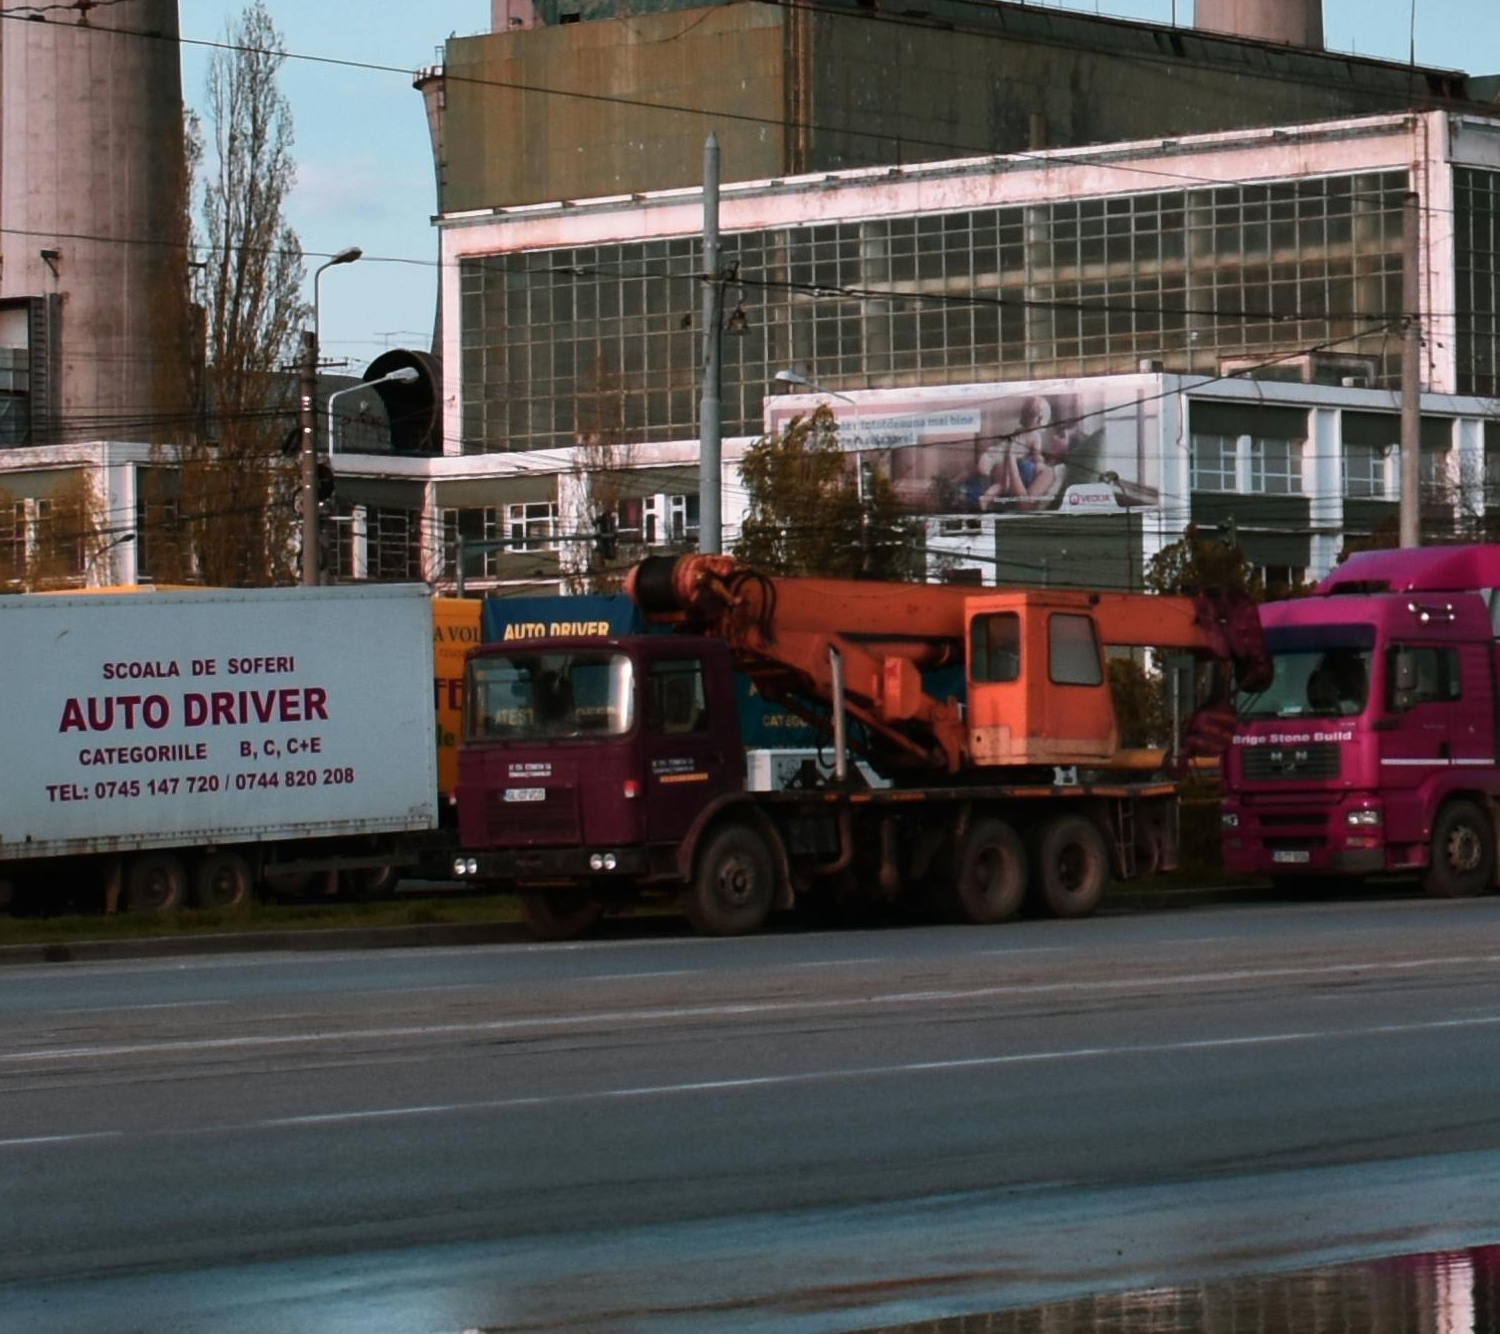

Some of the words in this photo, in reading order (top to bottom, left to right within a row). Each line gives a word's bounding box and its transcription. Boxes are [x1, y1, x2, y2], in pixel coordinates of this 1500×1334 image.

[503, 621, 546, 641] AUTO
[550, 621, 610, 639] DRIVER
[103, 661, 180, 680] SCOALA
[192, 659, 216, 676] DE
[227, 656, 295, 675] SOFERI
[58, 694, 170, 733] AUTO
[183, 687, 329, 727] DRIVER
[1270, 732, 1310, 744] Stone
[1313, 731, 1352, 742] Build
[79, 743, 208, 766] CATEGORIILE
[240, 740, 258, 760] B,
[263, 739, 281, 759] C,
[286, 737, 322, 755] C+E
[46, 785, 89, 803] TEL:
[94, 780, 140, 799] 0745
[147, 778, 180, 796] 147
[186, 775, 220, 794] 720
[235, 771, 279, 791] 0744
[285, 769, 317, 788] 820
[323, 767, 355, 785] 208
